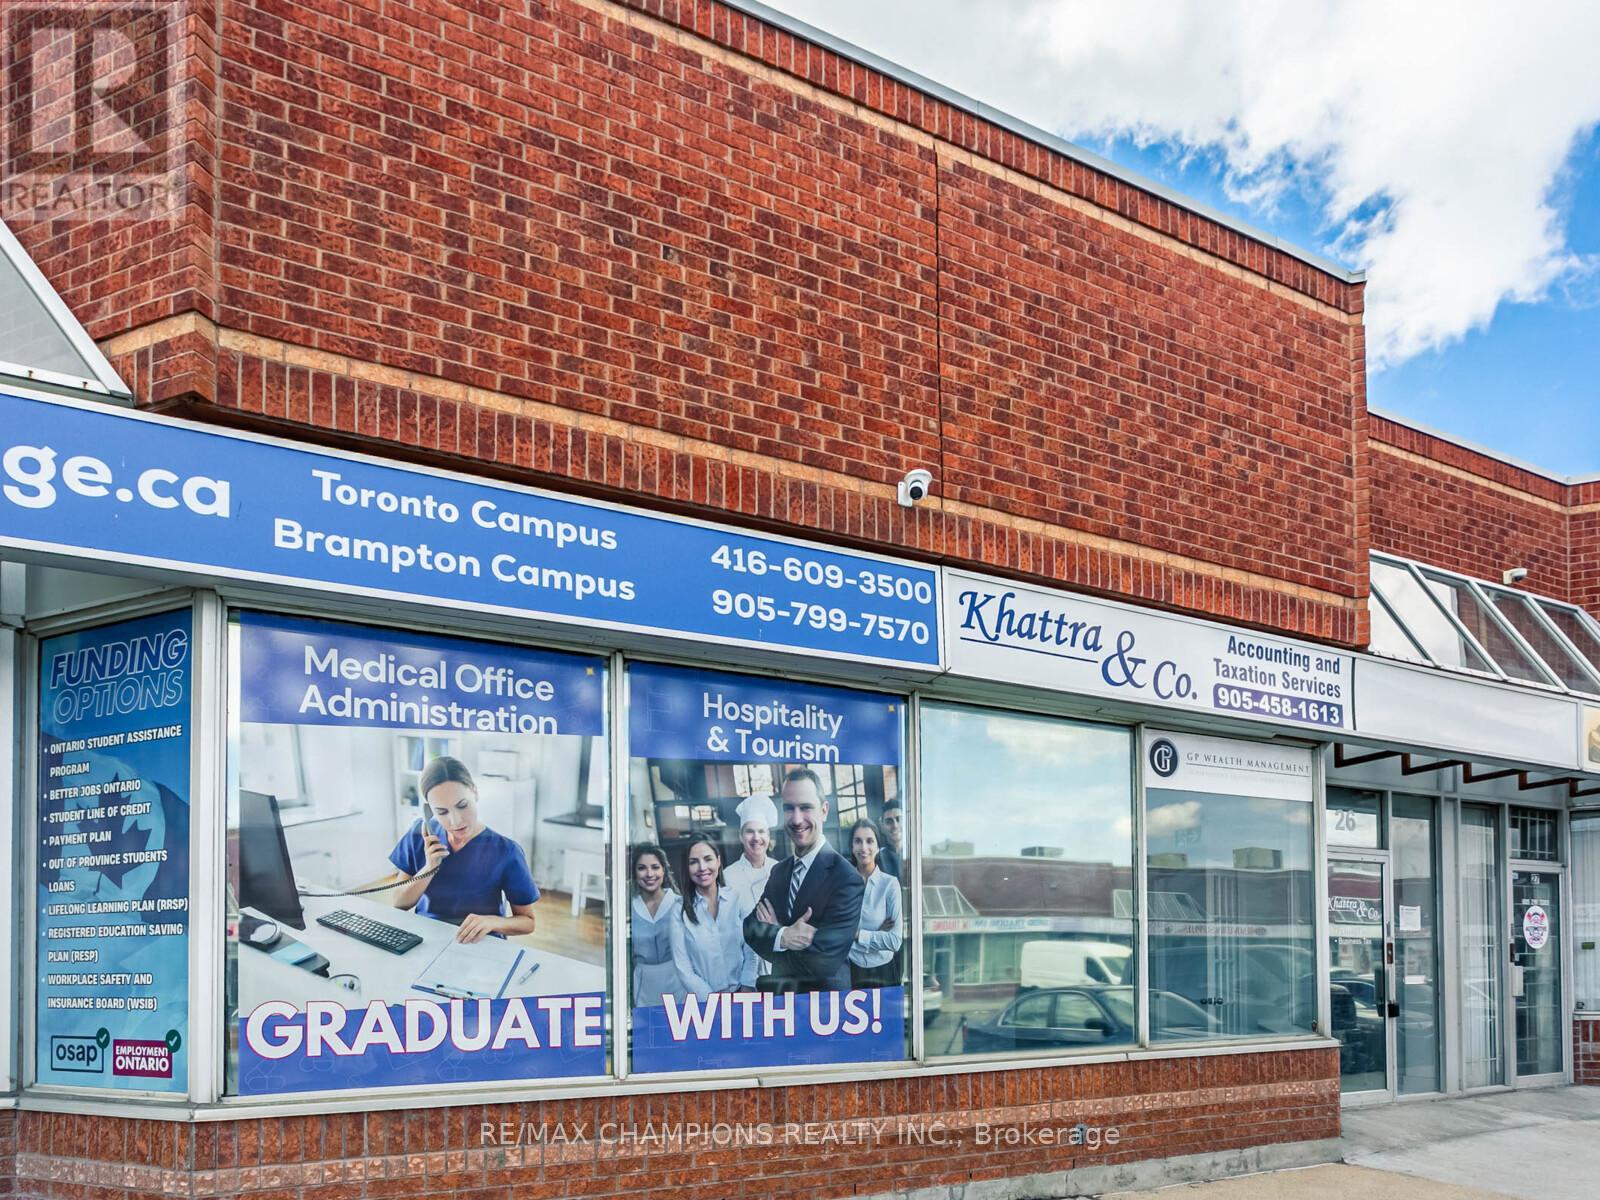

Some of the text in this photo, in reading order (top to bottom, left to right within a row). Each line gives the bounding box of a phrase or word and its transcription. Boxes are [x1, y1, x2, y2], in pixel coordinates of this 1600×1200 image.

[2, 445, 230, 518] ge.ca
[312, 469, 618, 550] Toronto Campus
[274, 518, 636, 601] Brampton Campus
[710, 544, 932, 605] 416-609-3500
[712, 589, 930, 645] 905-799-7570
[50, 629, 188, 689] FUNDING
[958, 591, 1197, 700] Khattra & Co.
[1227, 635, 1340, 675] Accounting and
[304, 645, 554, 702] Medical Office
[1213, 658, 1341, 698] Taxation Services
[53, 669, 184, 724] OPTIONS
[299, 684, 558, 736] Administration
[1217, 687, 1340, 724] 905-458-1613
[703, 692, 843, 739] Hospitality
[50, 725, 182, 754] ONTARIO STUDENT ASSISTANCE
[706, 726, 840, 763] & Tourism
[50, 763, 90, 778] PROGRAM
[1186, 752, 1311, 773] GP WEALTH MANAGEMENT
[49, 780, 141, 801] BETTER JOBS ONTARIO
[49, 803, 151, 824] STUDENT LINE OF CREDIT
[1335, 809, 1356, 832] 26
[49, 831, 112, 846] PAYMENT PLAN
[49, 850, 168, 869] OUT OF PROVINCE STUDENTS
[48, 881, 75, 892] LOANS
[48, 898, 188, 916] LIFELONG LEARNING PLAN (RRSP)
[48, 924, 183, 939] REGISTERED EDUCATION SAVING
[48, 951, 99, 963] PLAN (RESP)
[48, 974, 153, 985] WORKPLACE SAFETY AND
[47, 997, 157, 1011] INSURANCE BOARD (WSIB)
[661, 988, 882, 1041] WITH US!
[246, 996, 602, 1059] GRADUATE
[56, 1043, 98, 1066] osap
[115, 1045, 168, 1057] EMPLOYMENT
[115, 1056, 169, 1072] ONTARIO
